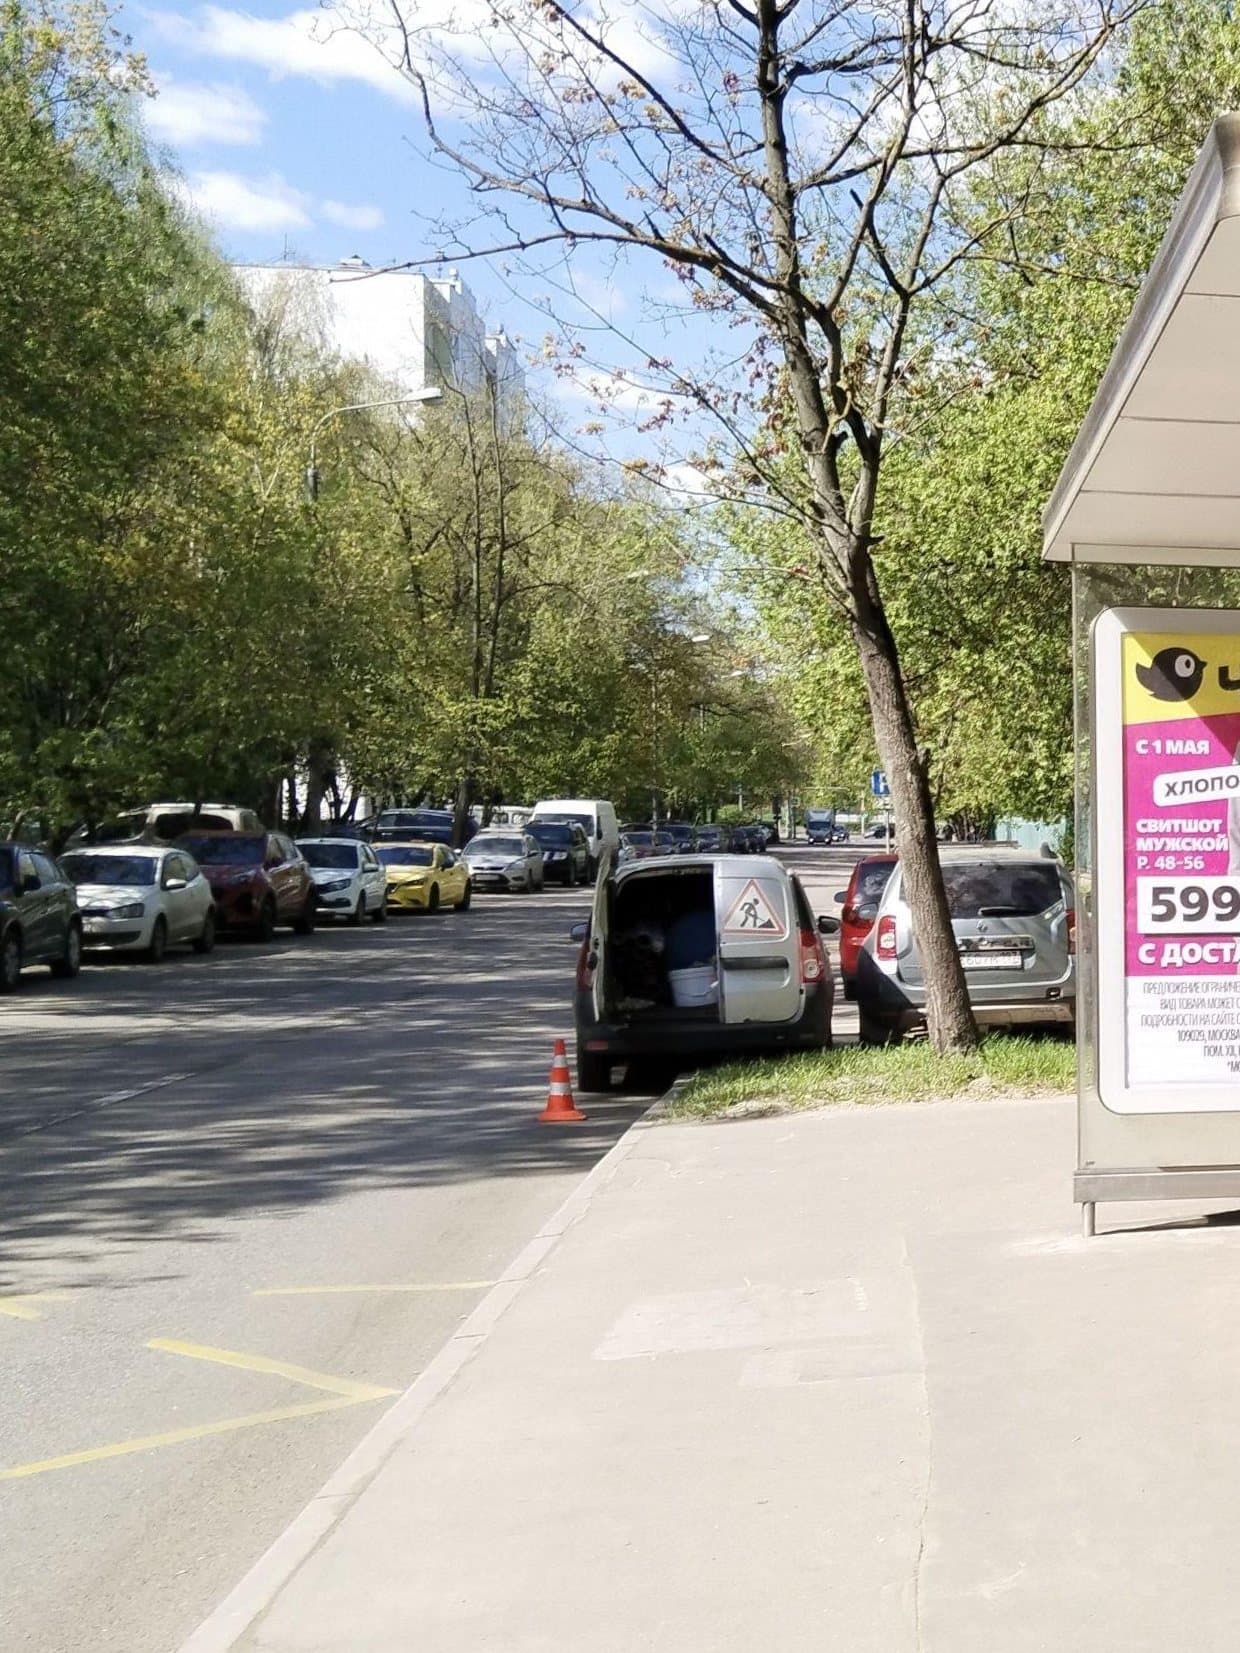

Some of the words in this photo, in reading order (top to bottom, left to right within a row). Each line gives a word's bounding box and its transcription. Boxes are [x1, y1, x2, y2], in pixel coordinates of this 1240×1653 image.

[1136, 739, 1149, 755] С
[1152, 740, 1161, 755] 1
[1166, 739, 1210, 755] МАЯ
[1136, 818, 1223, 834] СВИТШОТ
[1136, 834, 1229, 852] МУЖСКОЙ
[1155, 856, 1205, 870] 48-56
[1151, 886, 1240, 922] 599
[1138, 942, 1156, 965] С
